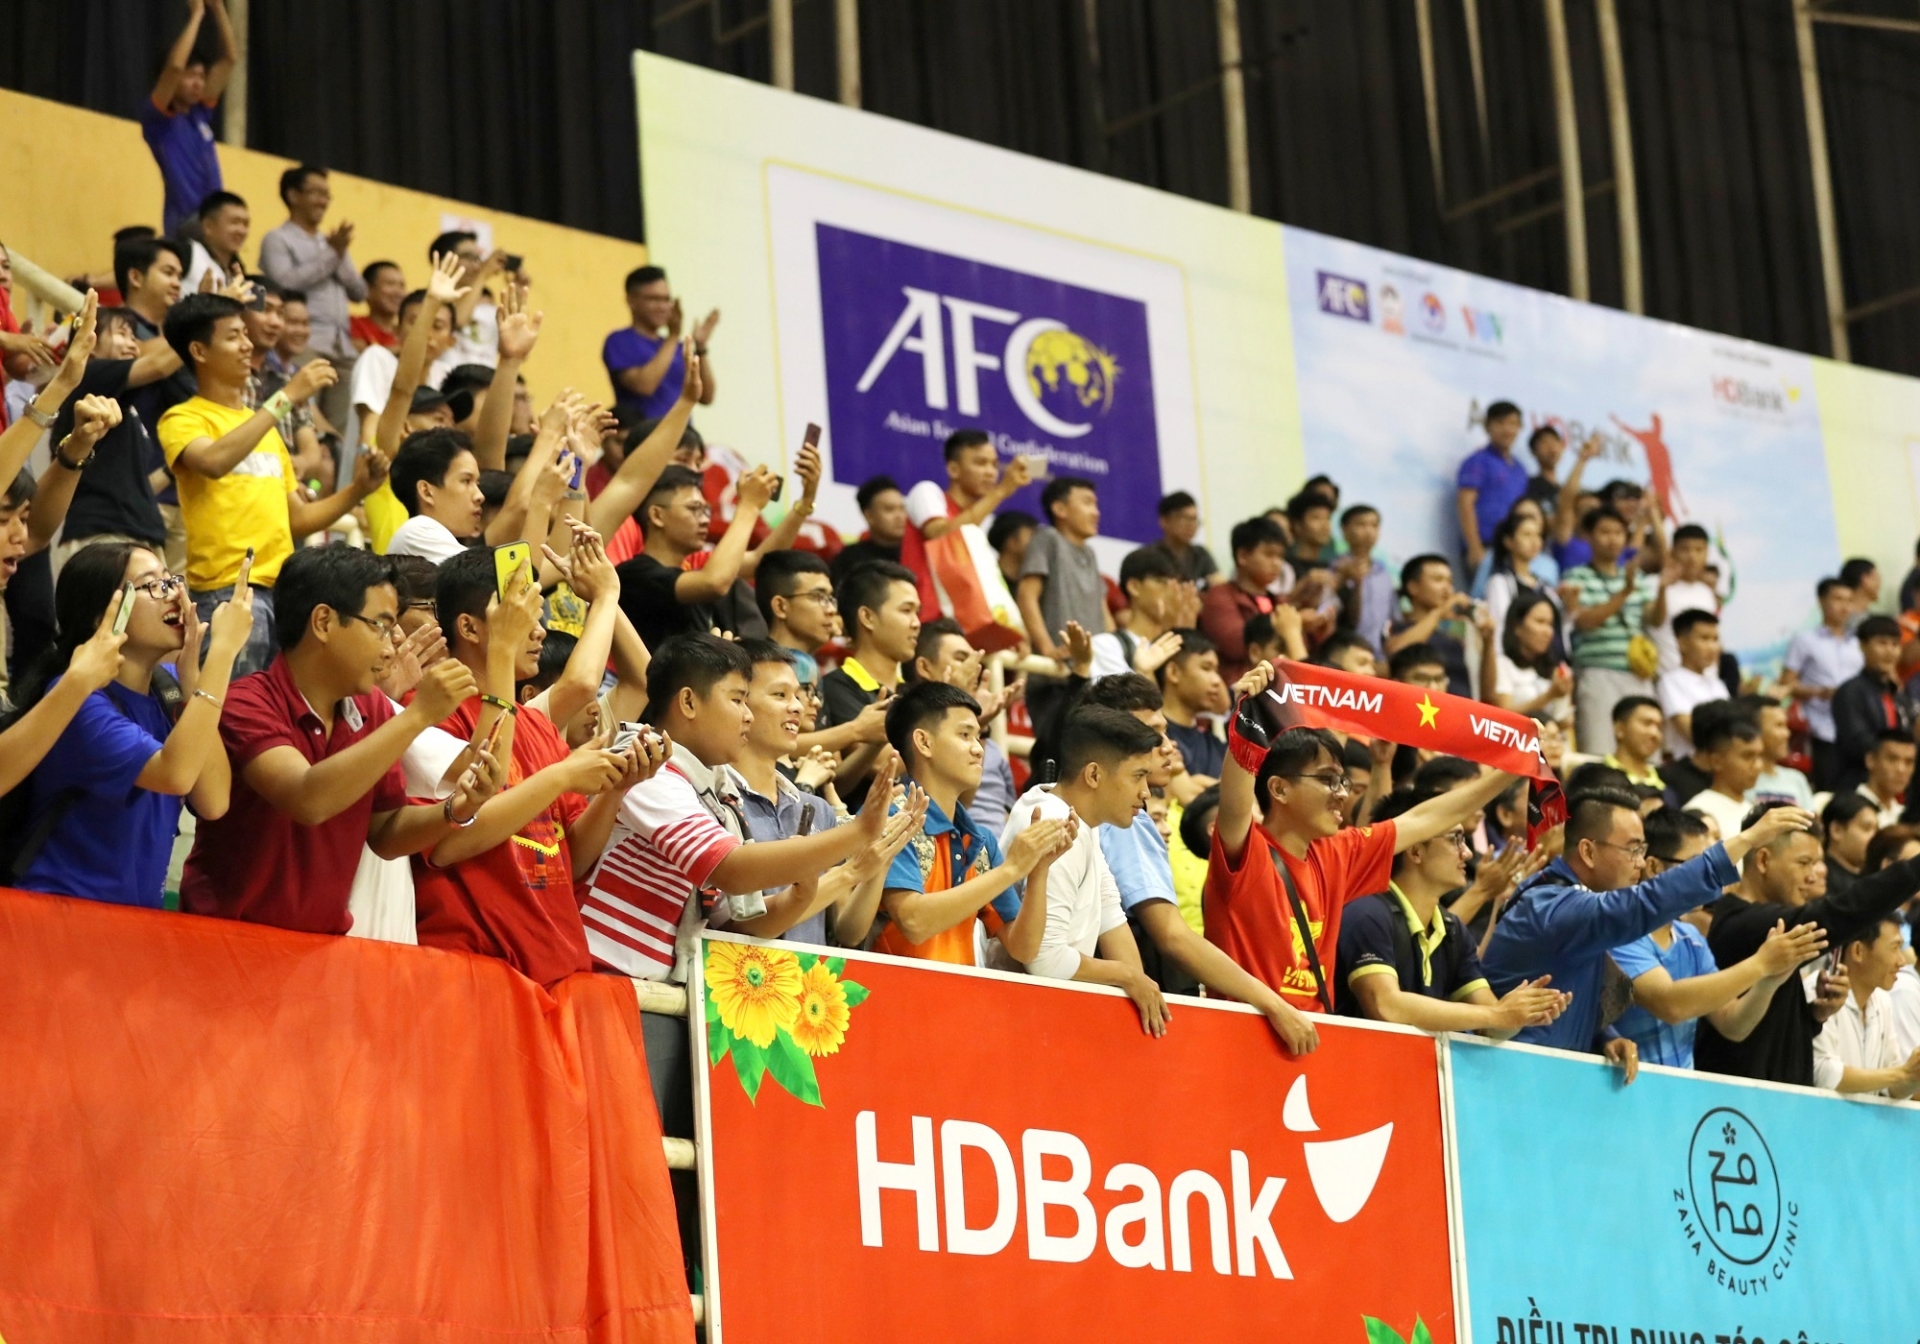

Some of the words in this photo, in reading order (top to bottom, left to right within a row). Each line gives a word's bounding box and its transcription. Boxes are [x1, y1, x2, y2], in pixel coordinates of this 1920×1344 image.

[855, 285, 1093, 438] AFC
[884, 410, 931, 435] Asian
[1265, 682, 1384, 714] VIETNAM
[1469, 713, 1546, 764] VIETNA
[855, 1110, 1295, 1280] HDBank
[1673, 1188, 1702, 1257] ZAHA
[1707, 1258, 1768, 1296] BEAUTY
[1772, 1200, 1799, 1281] CLINIC
